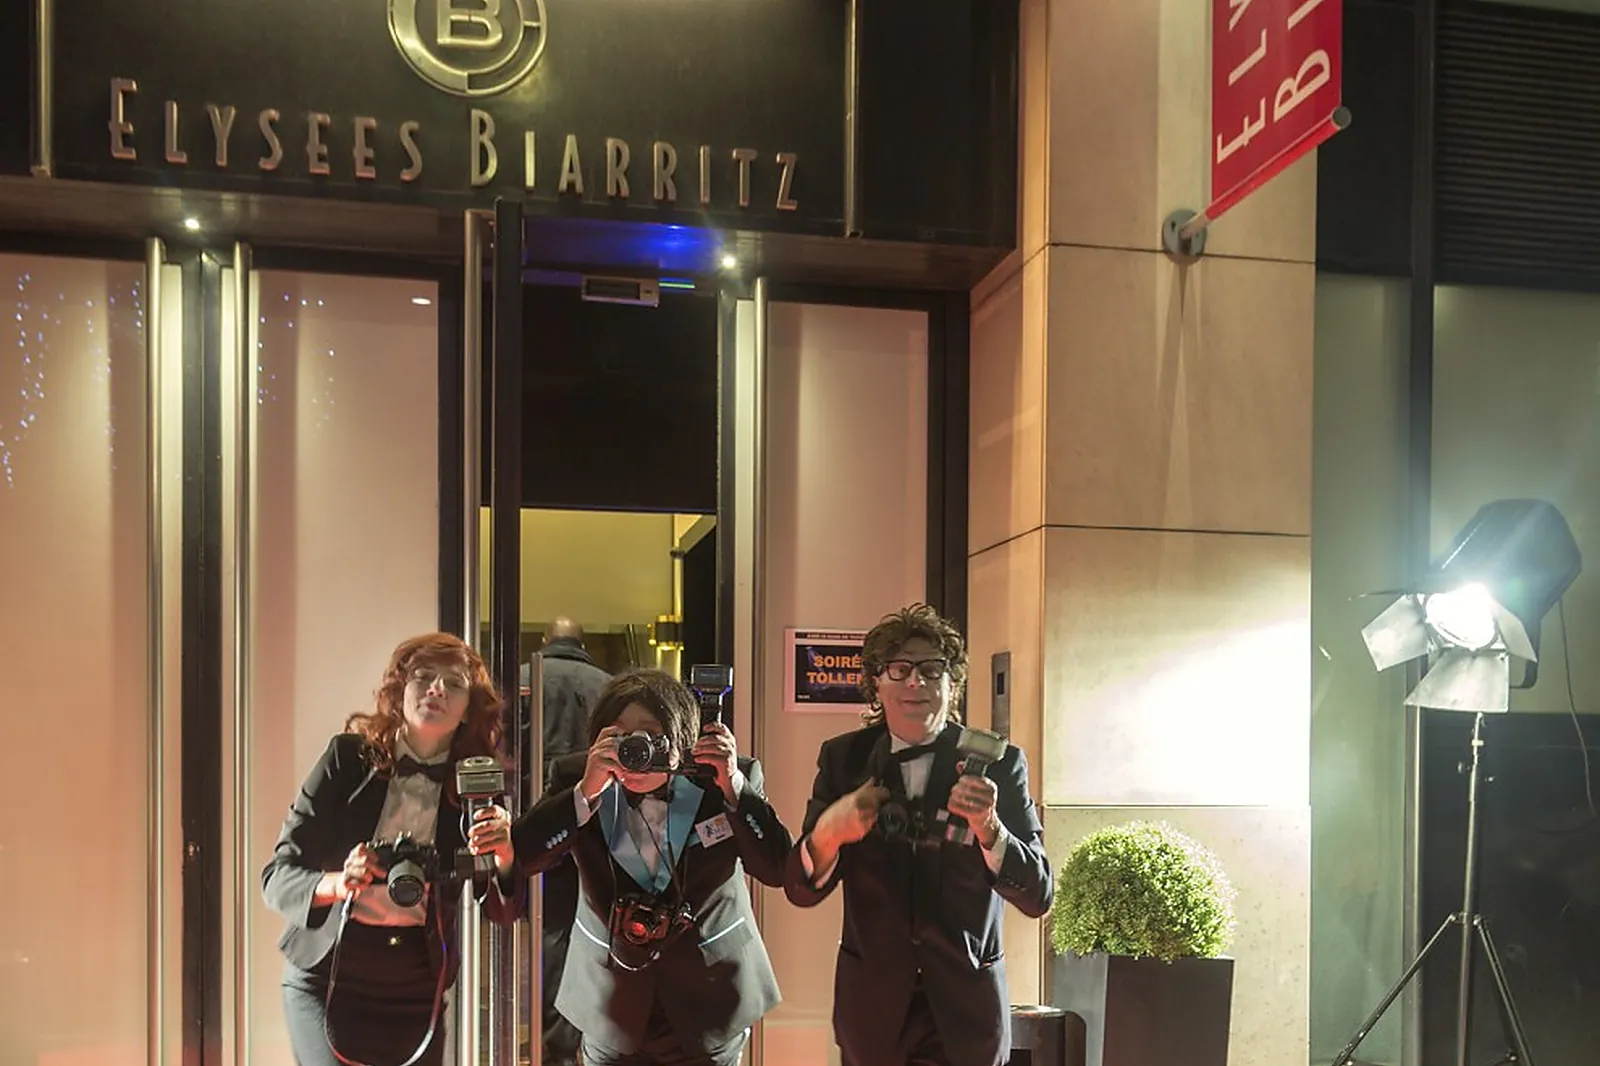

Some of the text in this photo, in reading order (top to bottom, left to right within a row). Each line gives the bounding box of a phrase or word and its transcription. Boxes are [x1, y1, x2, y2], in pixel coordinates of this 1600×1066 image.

[109, 78, 798, 210] ELYSEES BIARRITZ
[814, 654, 864, 668] SOIRÉ
